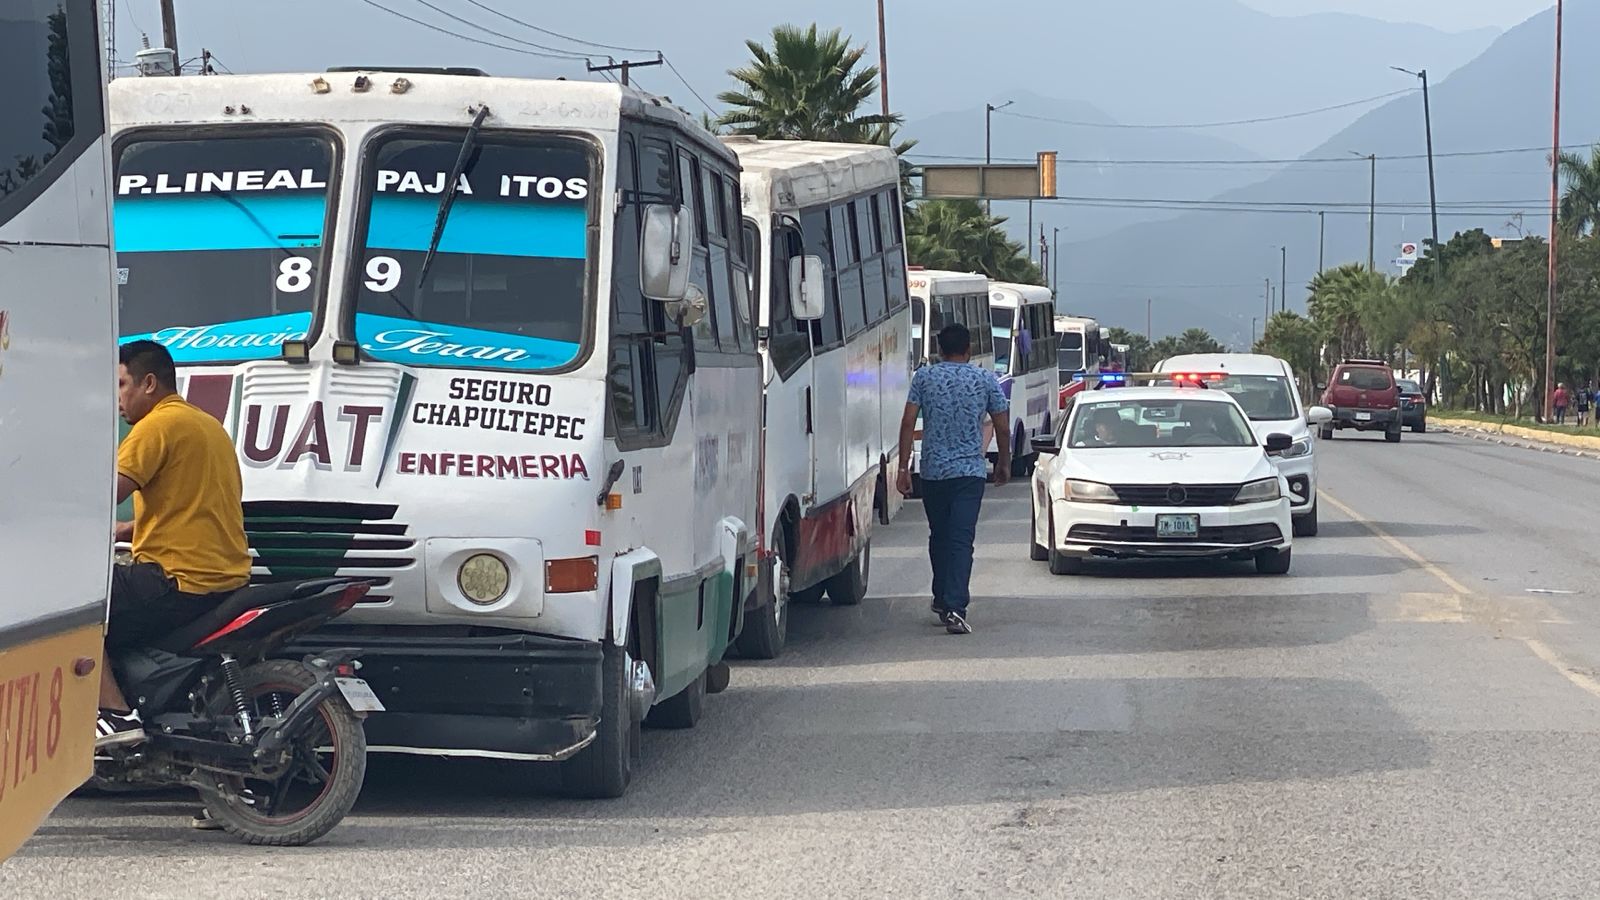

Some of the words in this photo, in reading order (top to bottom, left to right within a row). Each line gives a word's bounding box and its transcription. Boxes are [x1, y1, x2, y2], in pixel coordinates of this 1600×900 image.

[118, 168, 326, 195] P.LINEAL
[275, 256, 313, 293] 8
[364, 256, 402, 293] 9
[152, 324, 307, 349] Horacio
[361, 328, 530, 362] Teran
[449, 378, 552, 407] SEGURO
[243, 401, 384, 471] UAT
[413, 402, 586, 441] CHAPULTEPEC
[398, 452, 590, 481] ENFERMERIA
[46, 666, 63, 759] 8
